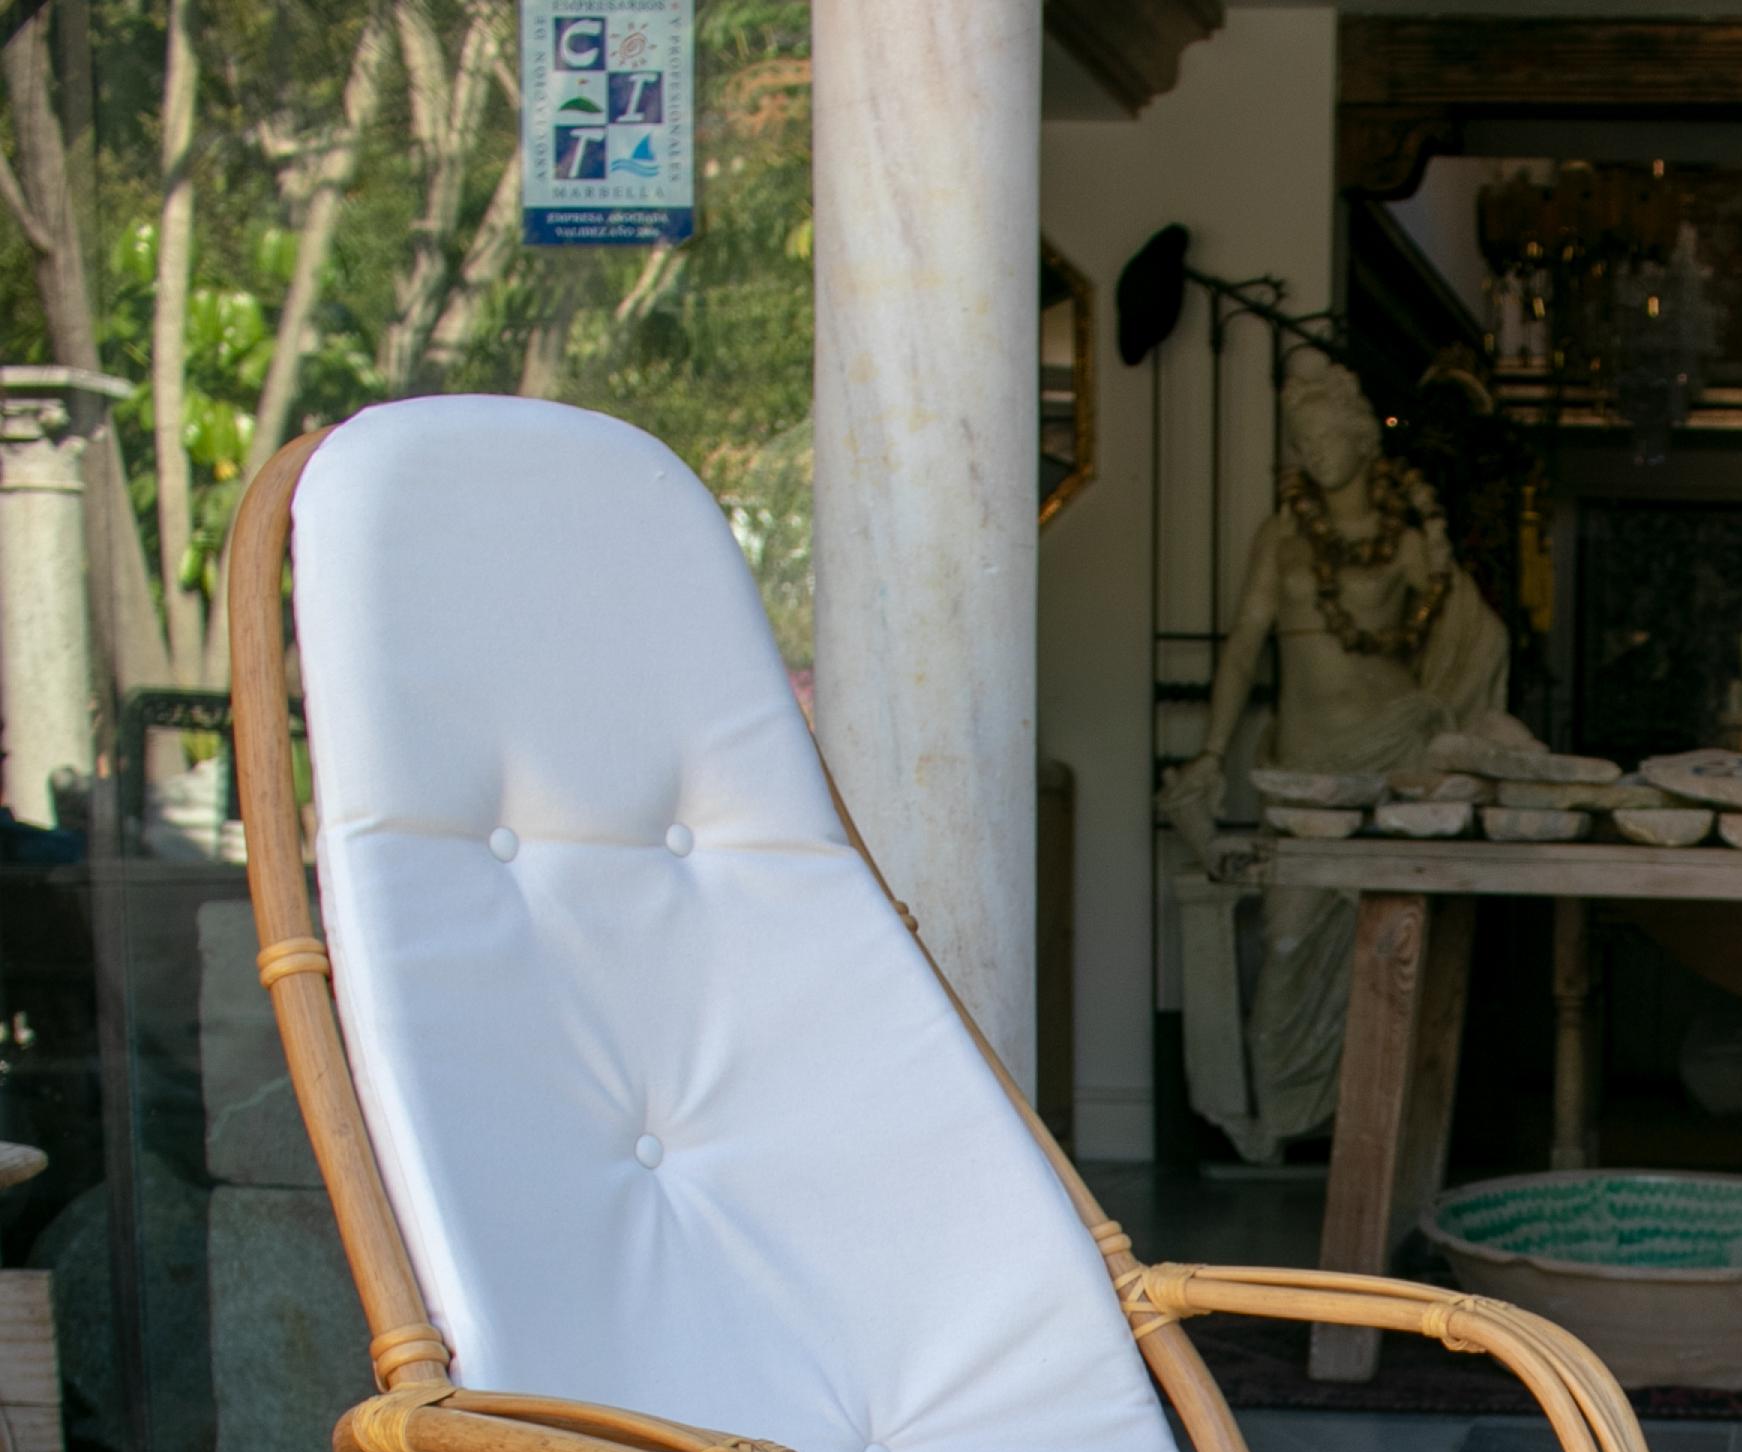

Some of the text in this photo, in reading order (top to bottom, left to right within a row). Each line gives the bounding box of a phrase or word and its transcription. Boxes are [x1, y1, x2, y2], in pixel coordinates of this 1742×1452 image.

[534, 15, 547, 41] DE
[669, 35, 681, 181] PROFESIONALES
[552, 186, 666, 199] MARBELLA
